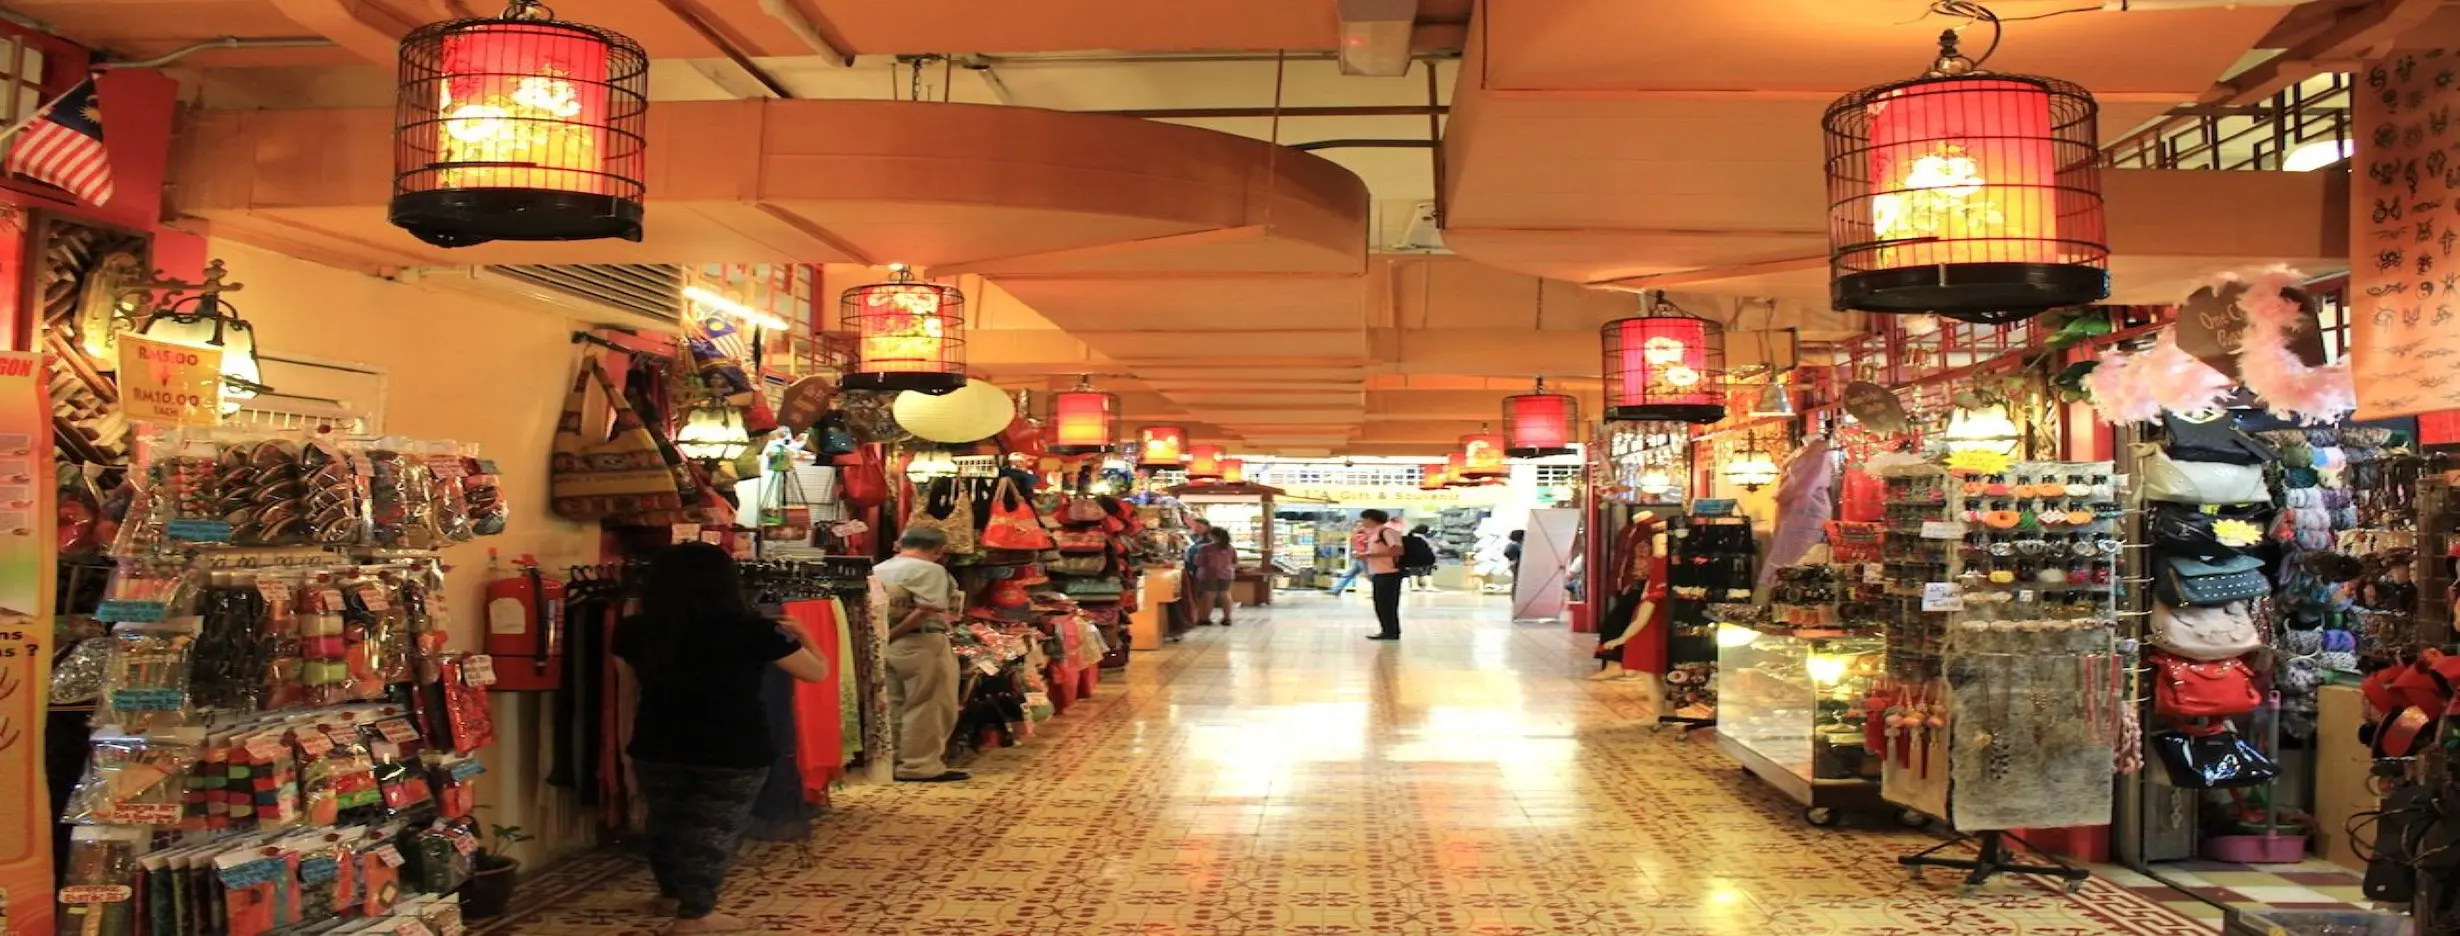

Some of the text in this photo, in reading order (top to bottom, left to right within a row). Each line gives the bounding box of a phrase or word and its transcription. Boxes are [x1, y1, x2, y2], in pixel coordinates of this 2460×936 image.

[138, 345, 199, 367] RM5.00
[133, 386, 200, 407] RM10.00
[1378, 491, 1387, 500] &
